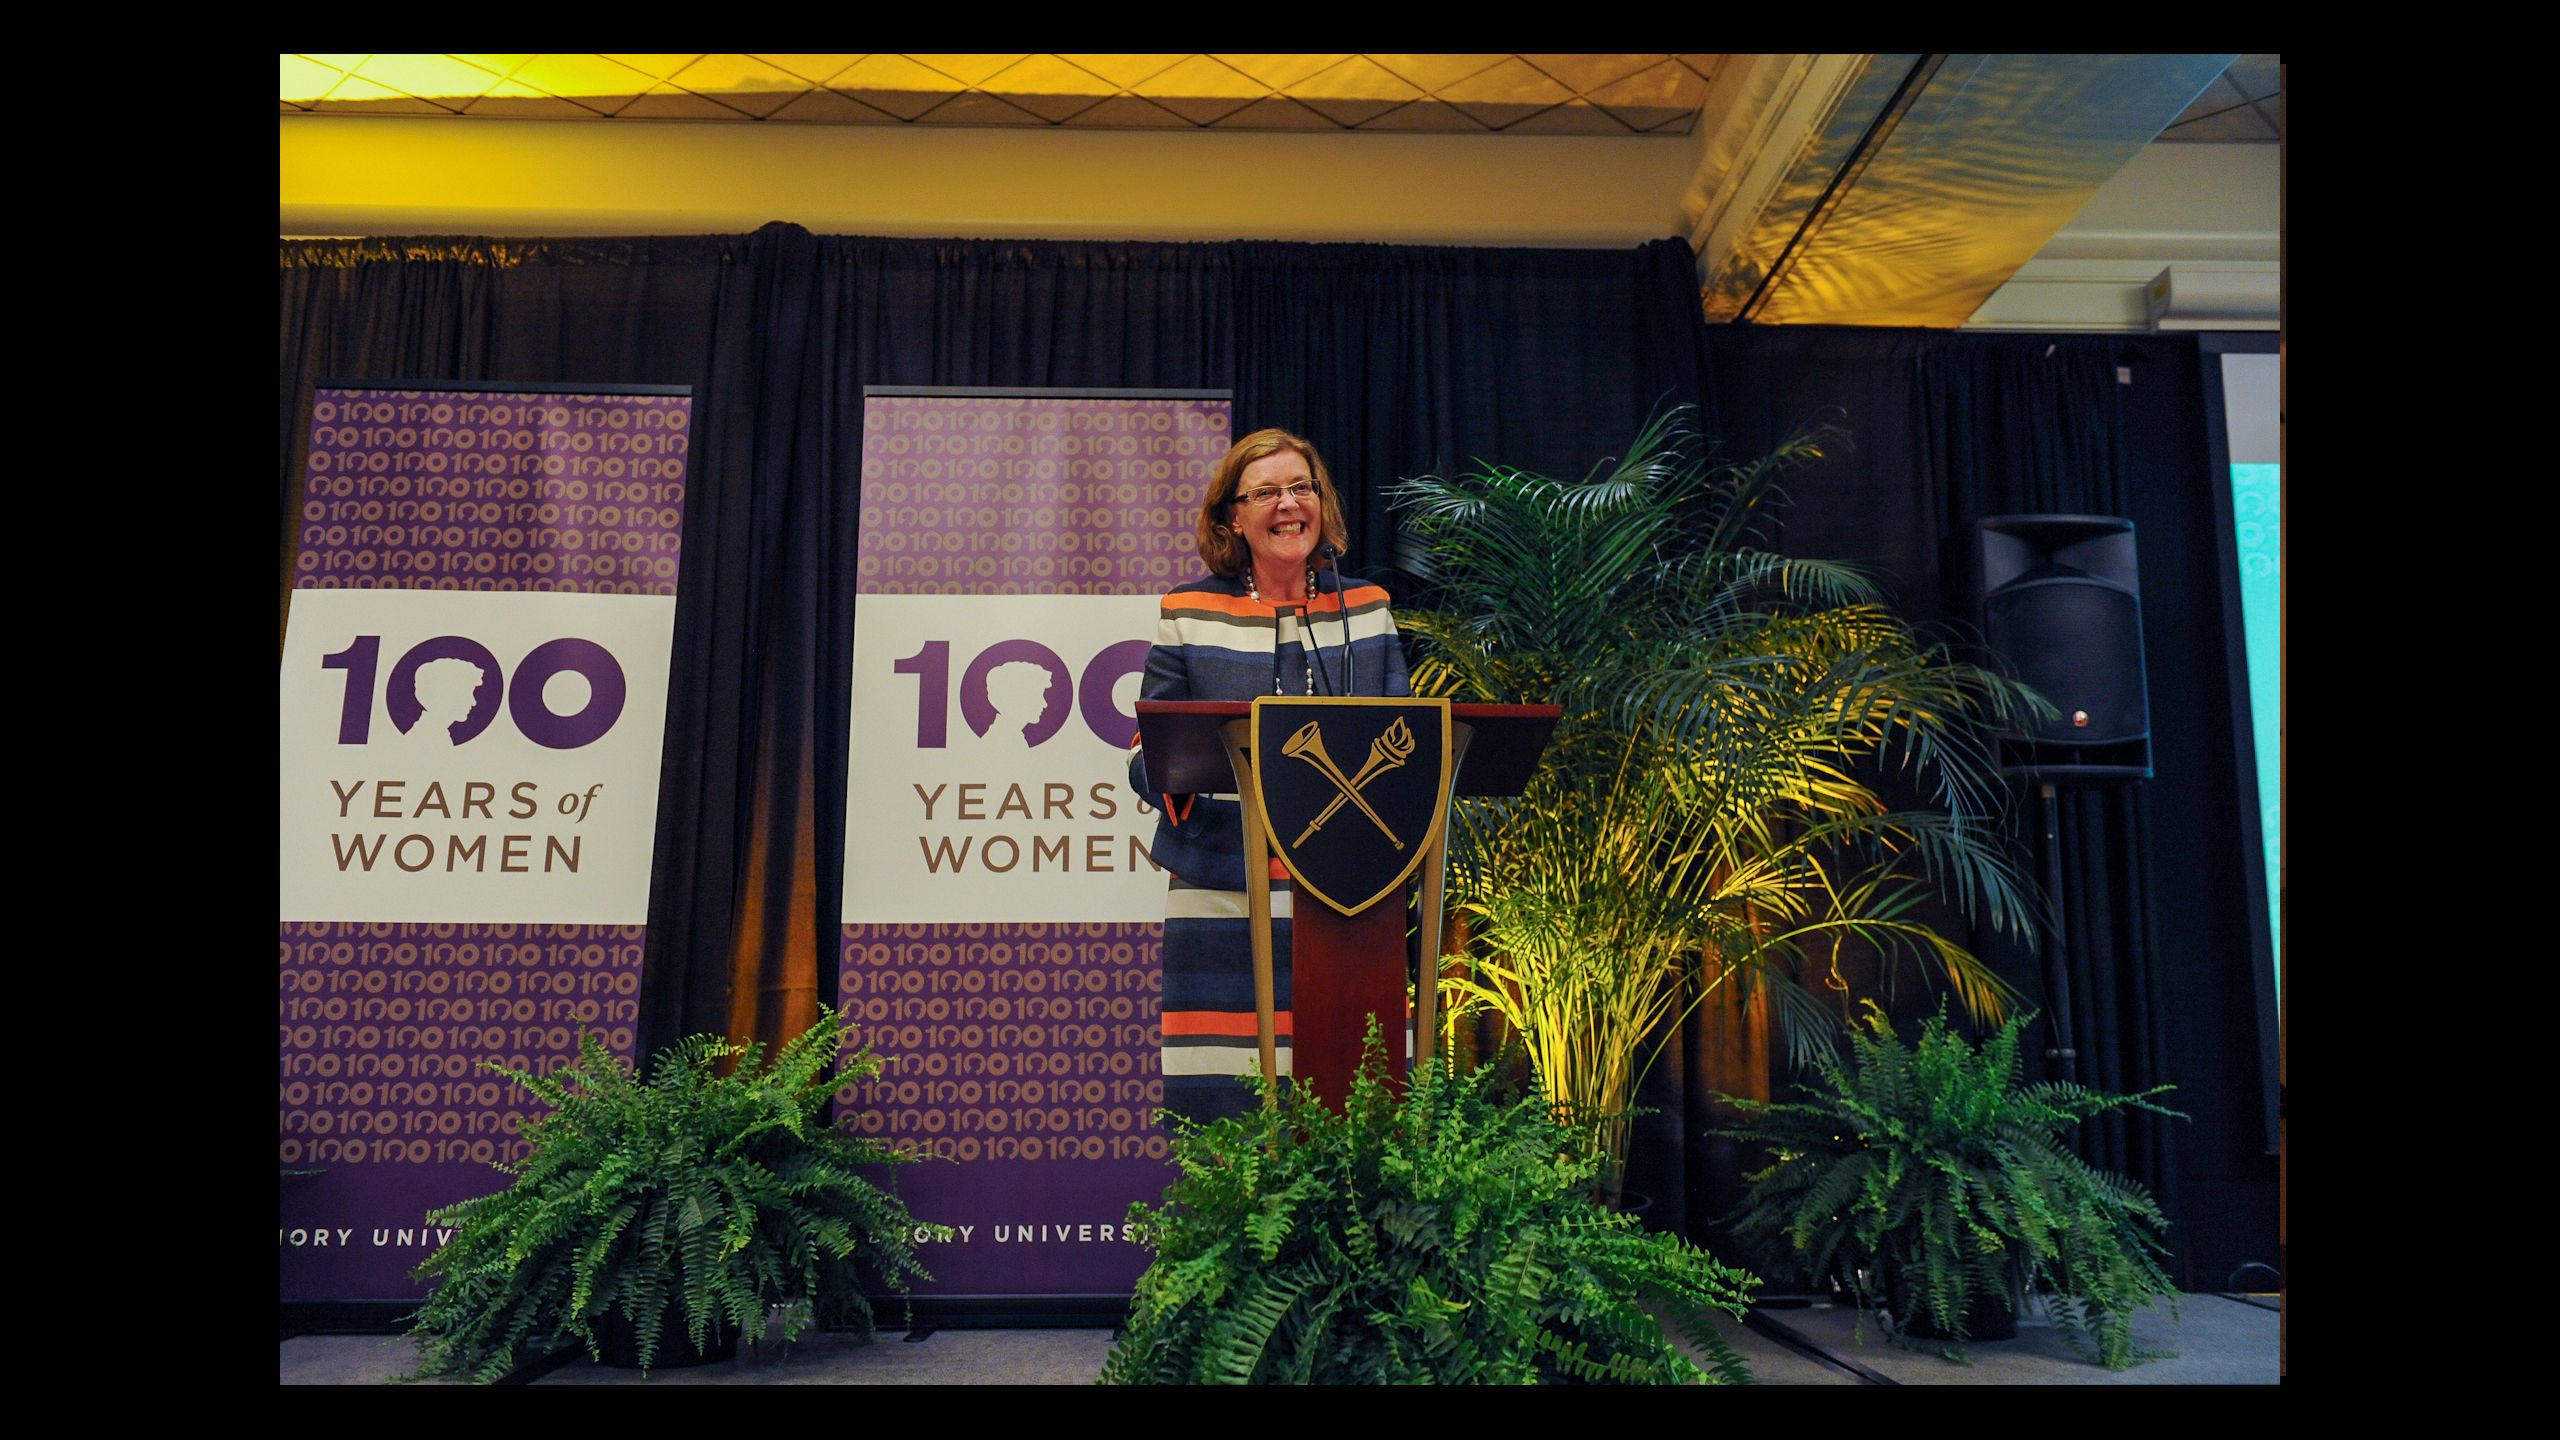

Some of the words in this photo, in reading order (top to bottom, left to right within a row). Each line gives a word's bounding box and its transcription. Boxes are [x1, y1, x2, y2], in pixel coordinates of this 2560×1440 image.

[321, 635, 626, 750] 100
[330, 780, 538, 819] YEARS
[557, 784, 604, 824] of
[913, 783, 1117, 820] YEARS
[331, 834, 581, 873] WOMEN
[280, 1228, 352, 1246] ORY
[373, 1228, 453, 1246] UNIV
